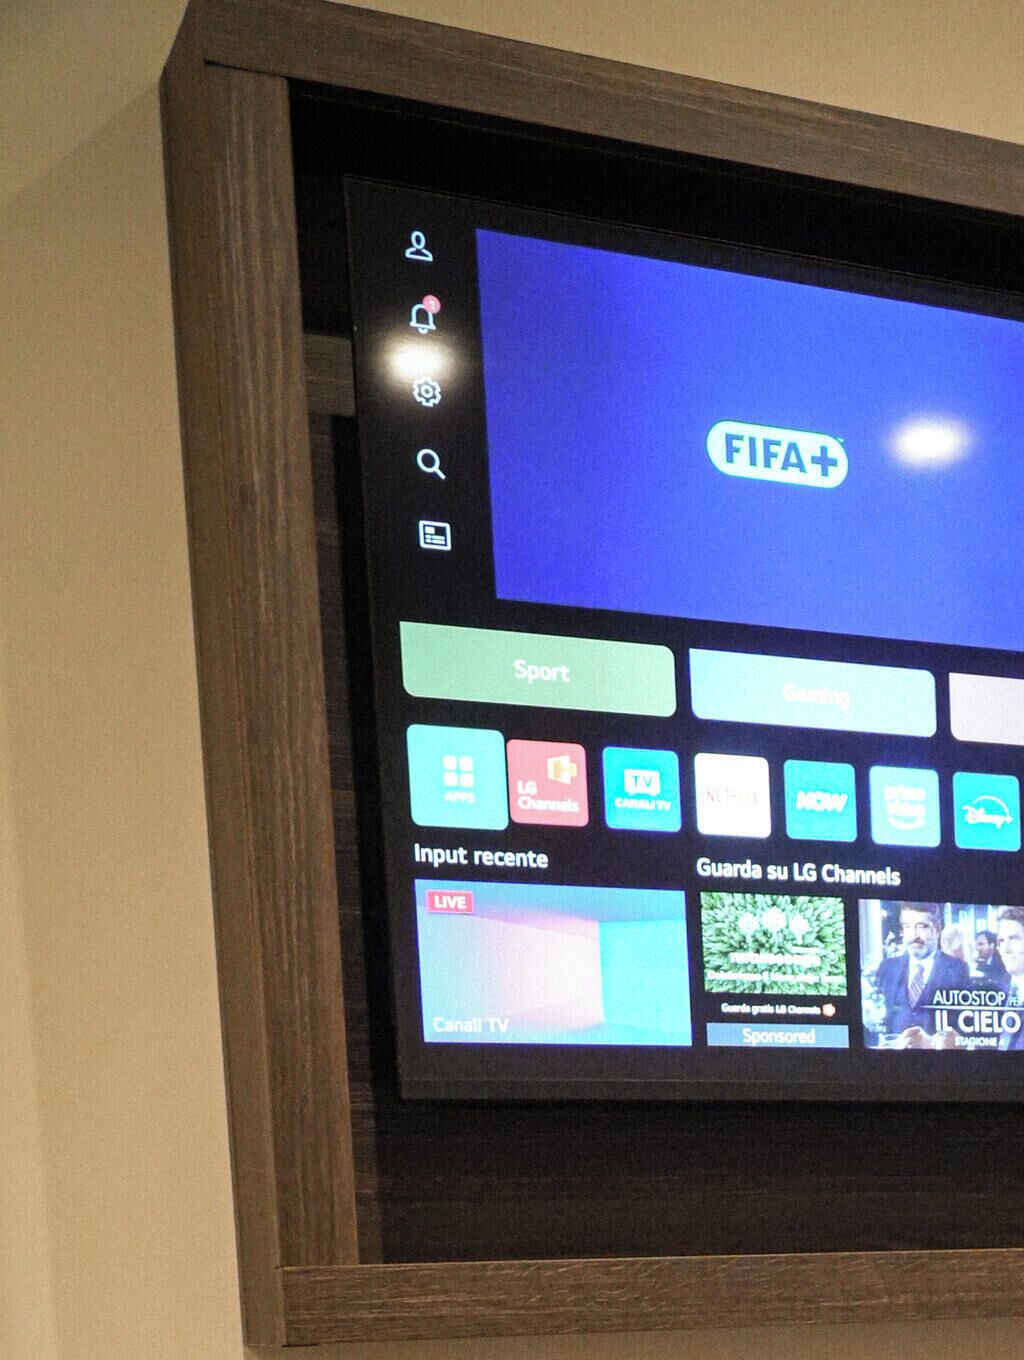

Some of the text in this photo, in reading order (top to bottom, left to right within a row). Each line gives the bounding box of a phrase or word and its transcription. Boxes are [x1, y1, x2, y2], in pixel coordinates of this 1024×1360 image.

[724, 433, 839, 478] FIFA+
[513, 658, 571, 684] Sport
[783, 683, 851, 711] Gaming
[517, 780, 537, 796] LG
[632, 775, 653, 788] TV
[517, 795, 580, 814] Channels
[656, 800, 672, 812] TV
[796, 790, 848, 813] NOW
[414, 843, 549, 870] Input recente
[696, 856, 902, 886] Guarda su LG Channels
[433, 893, 467, 911] LIVE
[932, 989, 1007, 1007] AUTOSTOP
[432, 1016, 510, 1034] Canali TV
[935, 1009, 1022, 1034] IL CIELO
[742, 1028, 817, 1046] Sponsored
[954, 1036, 998, 1048] STAGIONE
